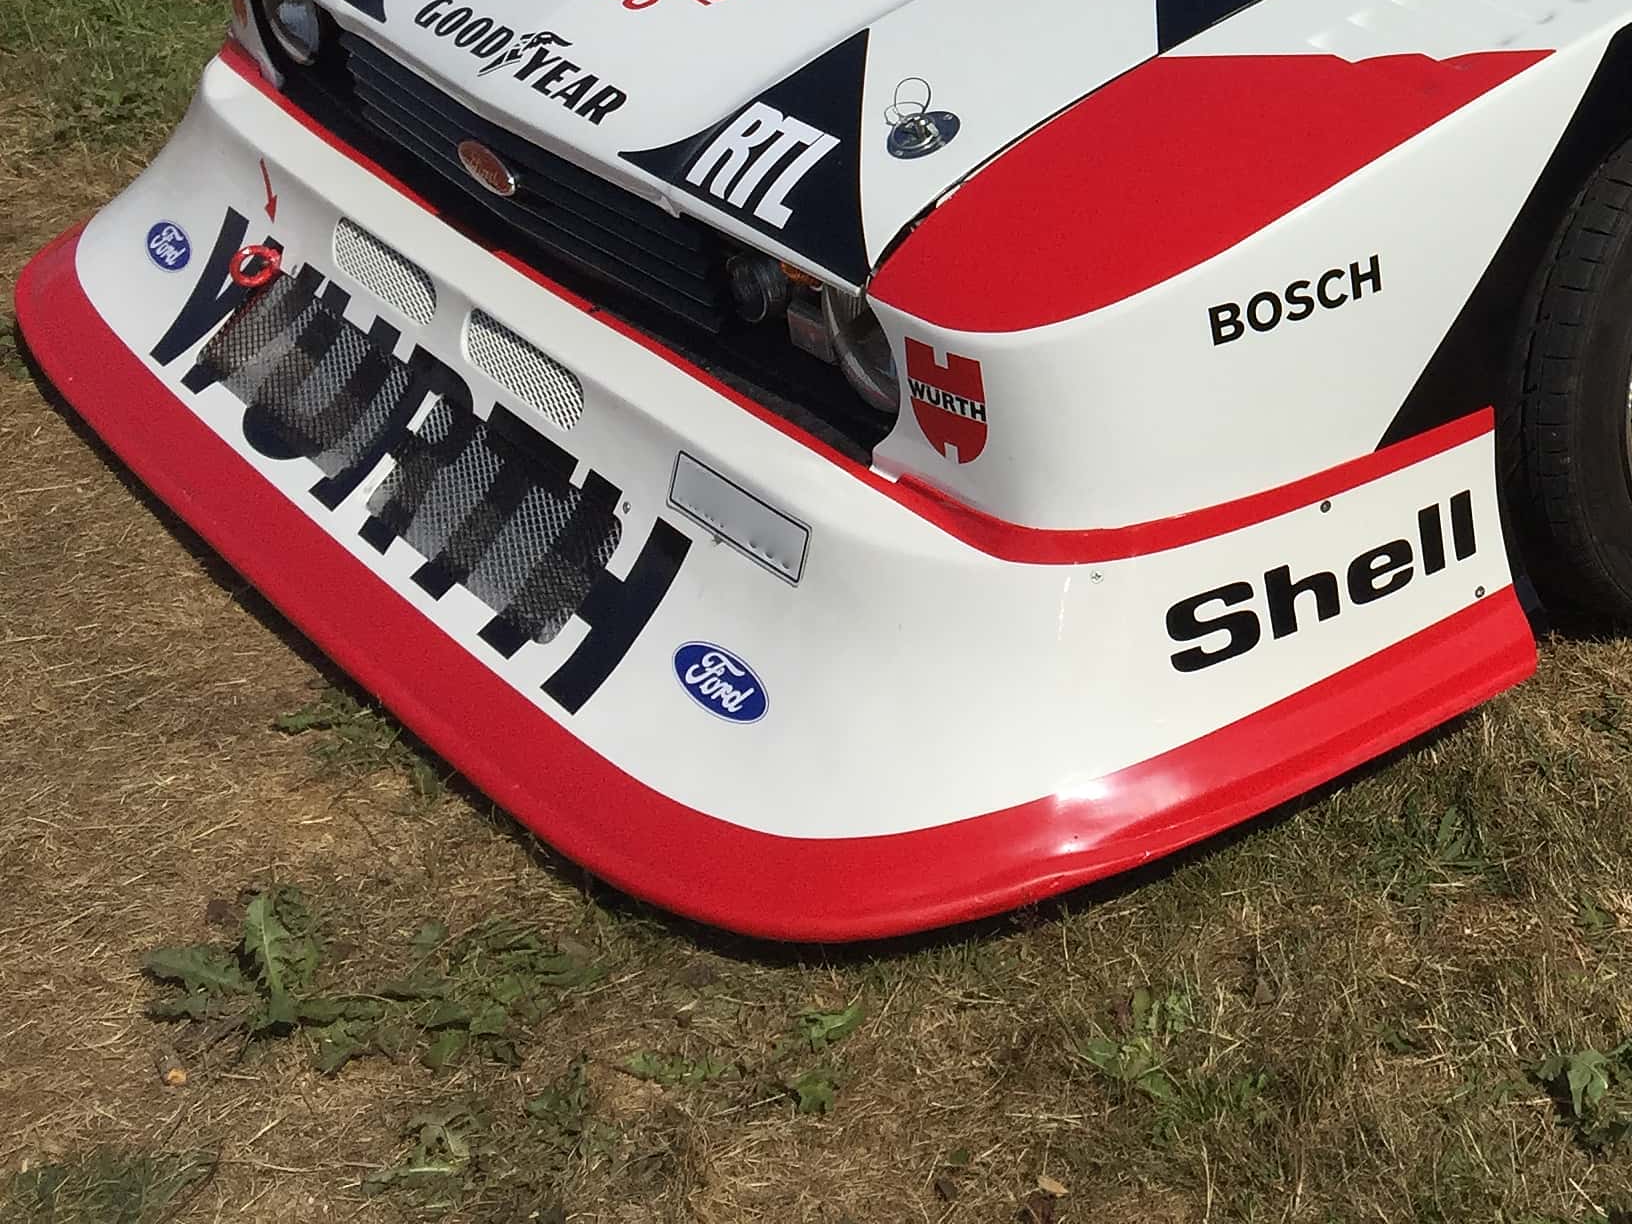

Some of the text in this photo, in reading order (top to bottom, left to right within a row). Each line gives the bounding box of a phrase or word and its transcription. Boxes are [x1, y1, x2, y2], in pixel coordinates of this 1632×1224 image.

[685, 101, 841, 230] RTL
[148, 223, 188, 268] Ford
[1208, 254, 1383, 346] BOSCH
[1165, 489, 1477, 673] Shell
[679, 647, 761, 718] Ford
